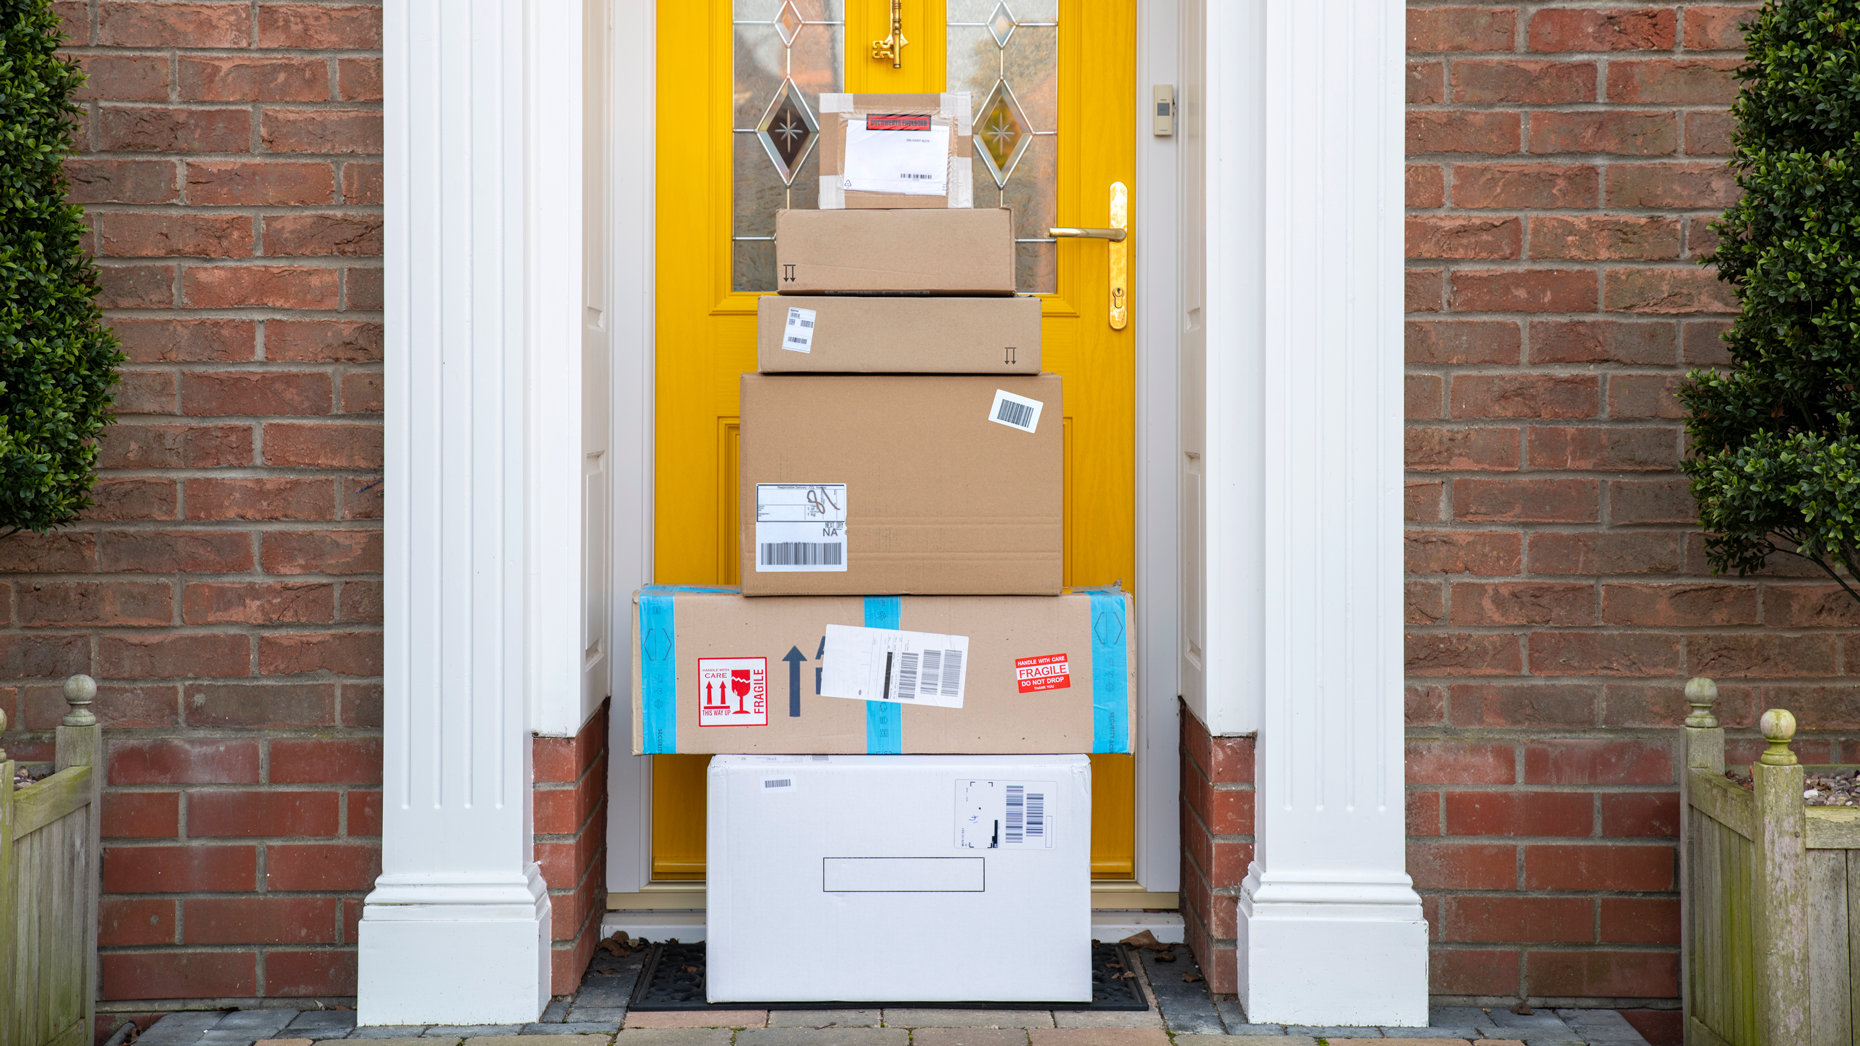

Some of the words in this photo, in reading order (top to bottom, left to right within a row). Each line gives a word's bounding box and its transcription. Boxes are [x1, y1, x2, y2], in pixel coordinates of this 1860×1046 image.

[823, 528, 838, 536] NA
[1019, 664, 1067, 678] FRAGILE
[754, 669, 764, 714] FRAGILE
